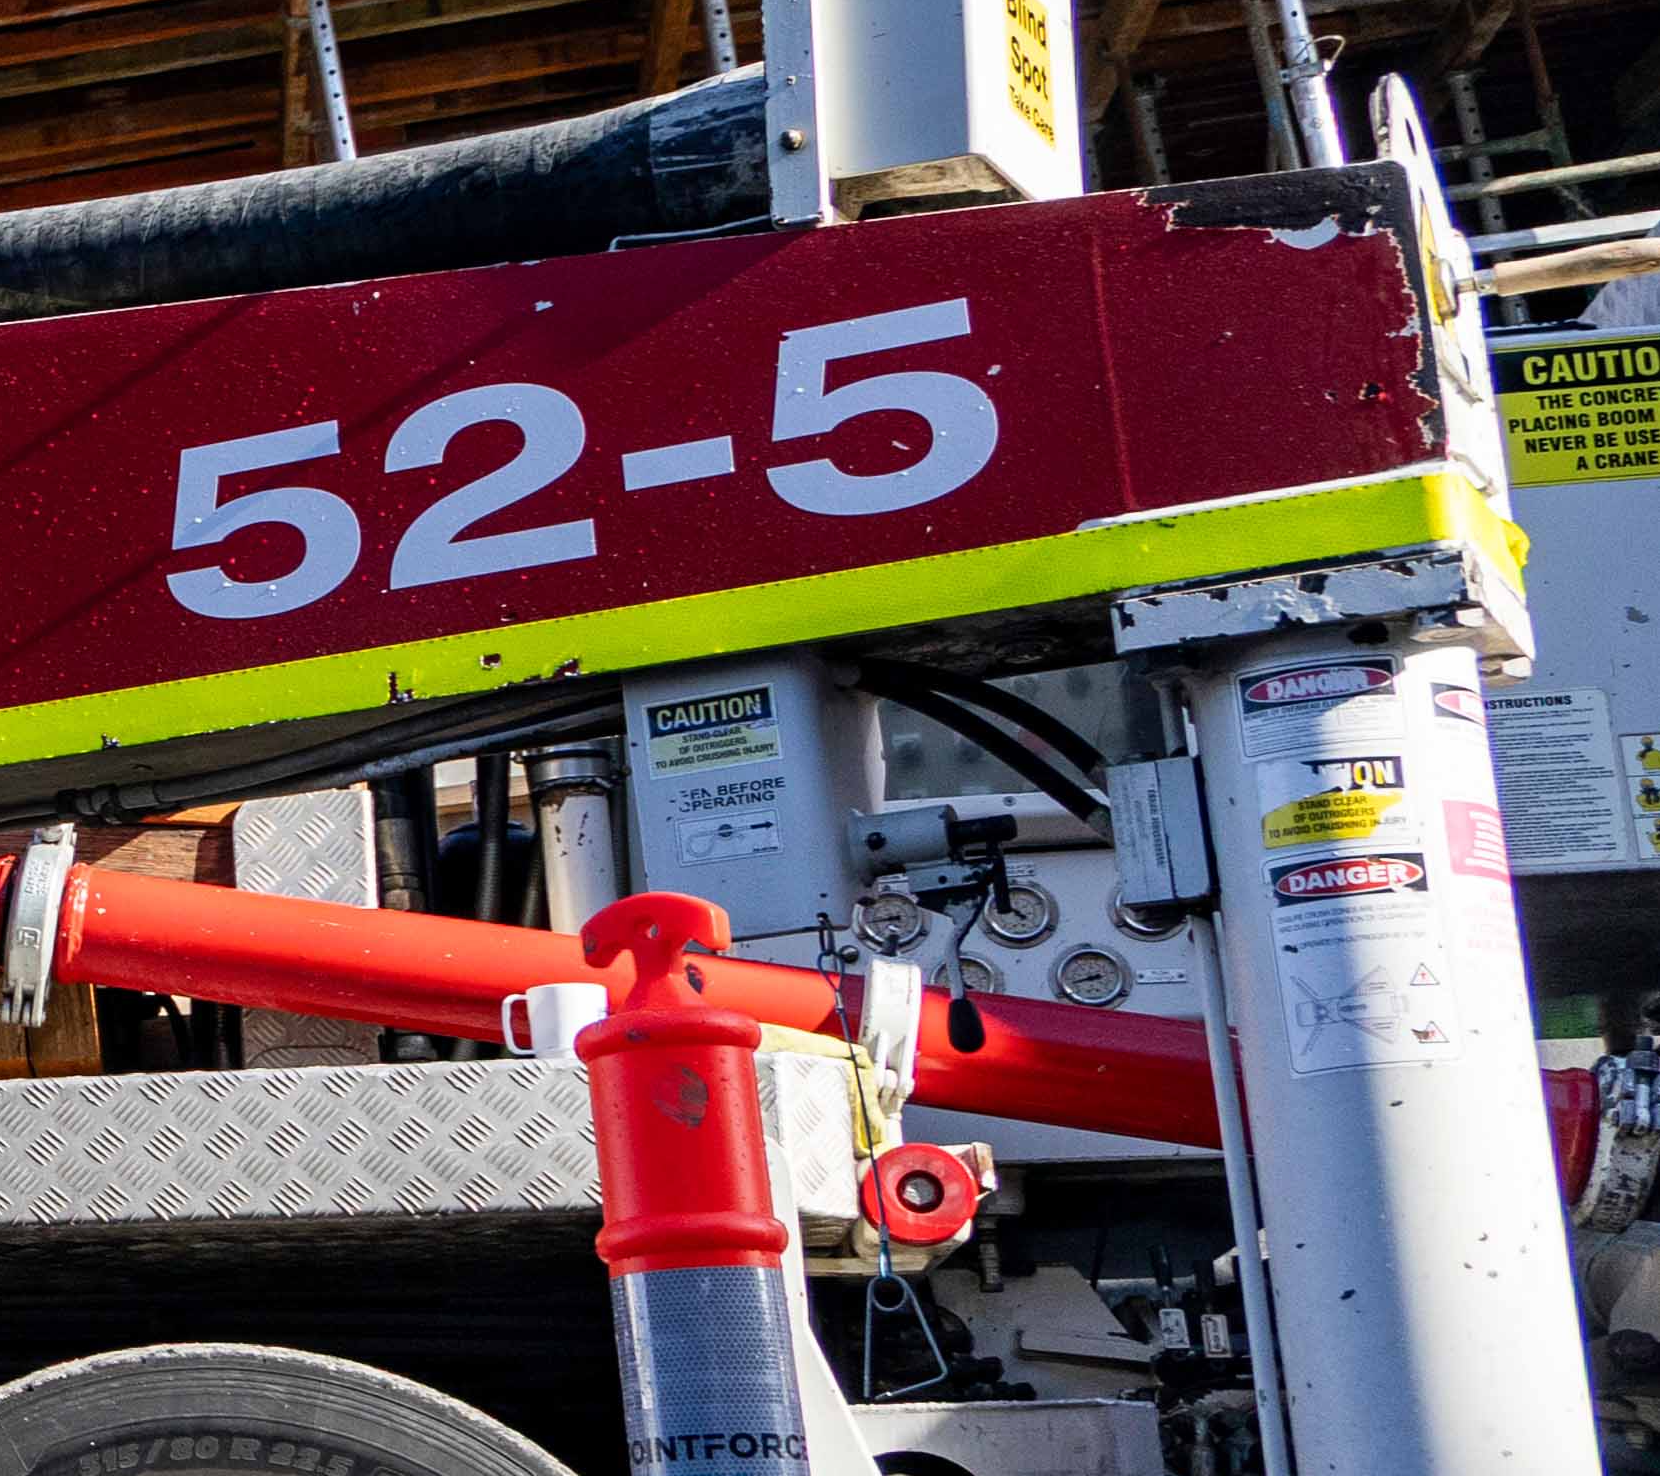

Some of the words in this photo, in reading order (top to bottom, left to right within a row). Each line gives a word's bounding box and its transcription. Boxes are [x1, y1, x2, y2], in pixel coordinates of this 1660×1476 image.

[1011, 36, 1049, 101] Spot
[1536, 393, 1573, 410] THE
[1508, 413, 1591, 433] PLACING
[1597, 408, 1656, 427] BOOM
[1524, 435, 1586, 453] NEVER
[1593, 432, 1618, 448] BE
[166, 297, 1000, 620] 52-5
[1576, 456, 1589, 470] A
[1594, 450, 1659, 469] CRANE
[656, 693, 763, 731] CAUTION
[1484, 694, 1572, 710] STRUCTIONS
[655, 760, 667, 769] TO
[669, 756, 695, 768] AVOID
[697, 750, 741, 765] CRUSHING
[743, 742, 775, 756] INJURY
[679, 745, 691, 755] OF
[693, 736, 747, 753] OUTRIGGERS
[717, 776, 786, 796] BEFORE
[679, 790, 776, 813] OPERATING
[1297, 797, 1331, 811] STAND
[1333, 795, 1367, 807] CLEAR
[1293, 813, 1307, 824] OF
[1308, 807, 1375, 821] OUTRIGGERS
[1269, 828, 1280, 838] TO
[1282, 824, 1311, 836] AVOID
[1313, 819, 1367, 833] CRUSHING
[1287, 864, 1410, 893] DANGER
[229, 1436, 262, 1461] R
[630, 1431, 808, 1466] OINTFORC
